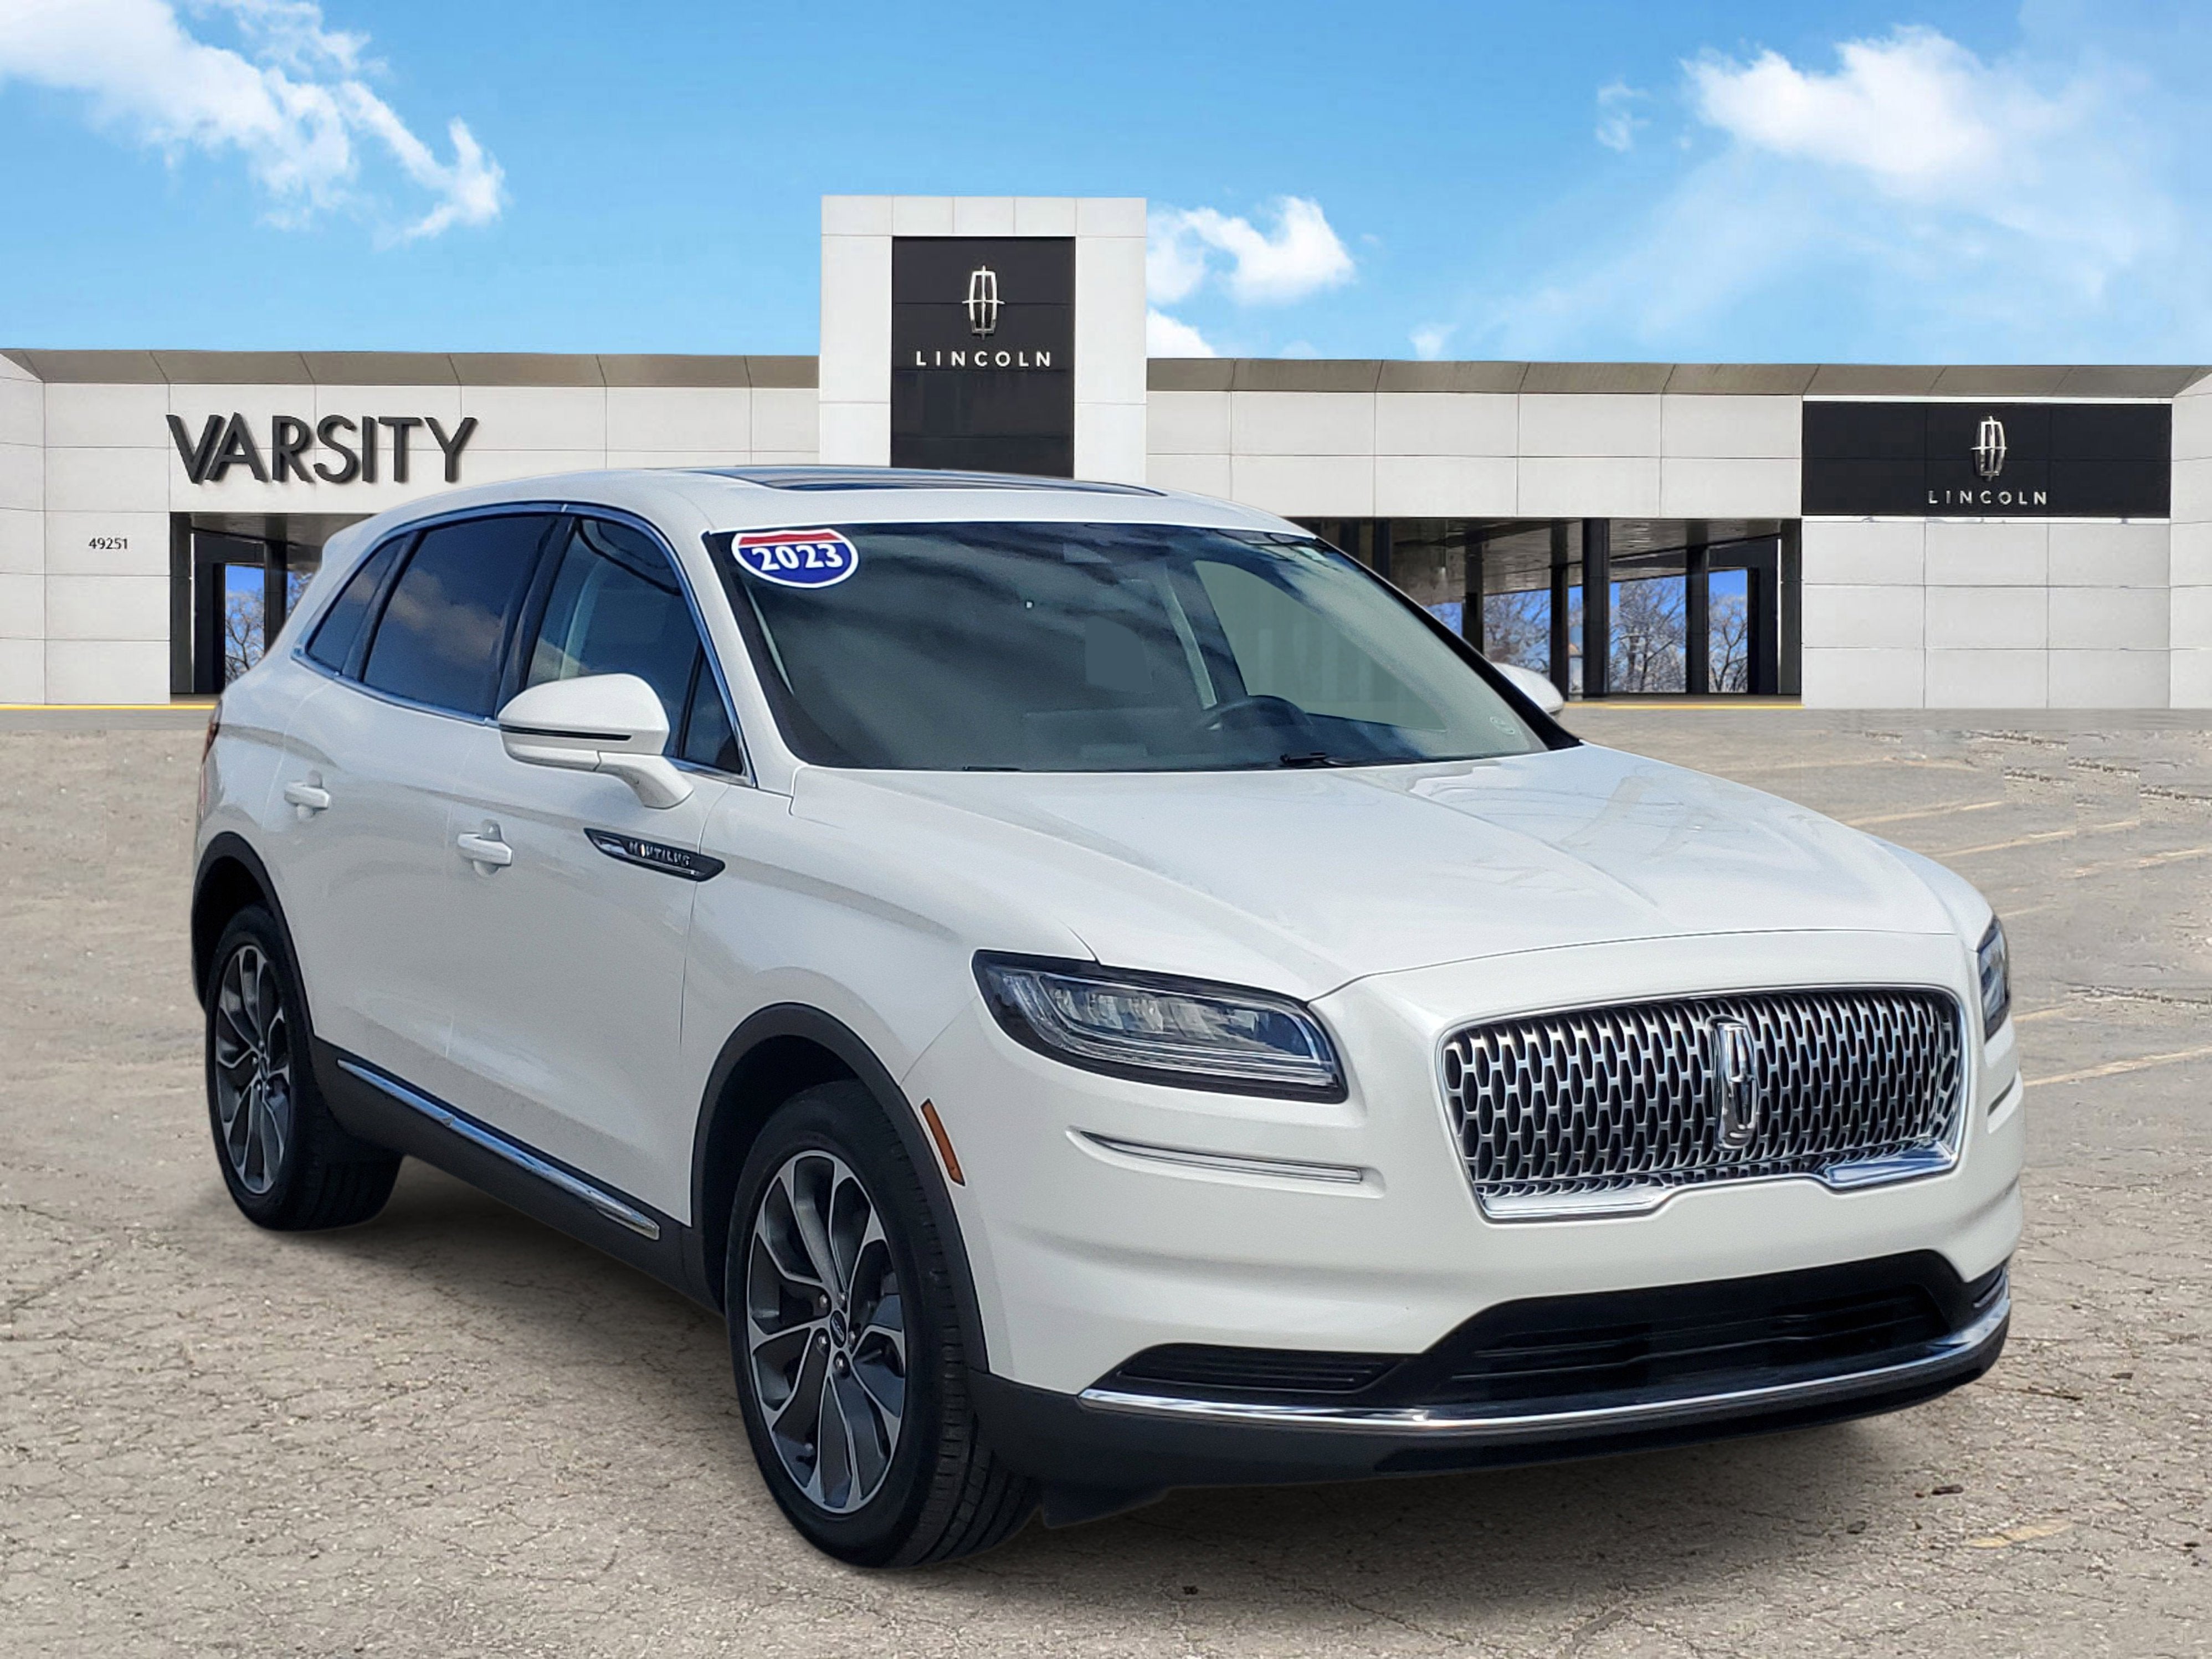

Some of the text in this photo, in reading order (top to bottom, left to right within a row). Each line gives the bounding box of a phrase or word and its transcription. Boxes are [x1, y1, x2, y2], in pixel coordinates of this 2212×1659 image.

[916, 351, 1050, 367] LINCOLN
[166, 413, 478, 484] VARSITY
[1928, 490, 2048, 505] LINCOLN
[88, 537, 128, 549] 49251
[751, 543, 844, 571] 2023
